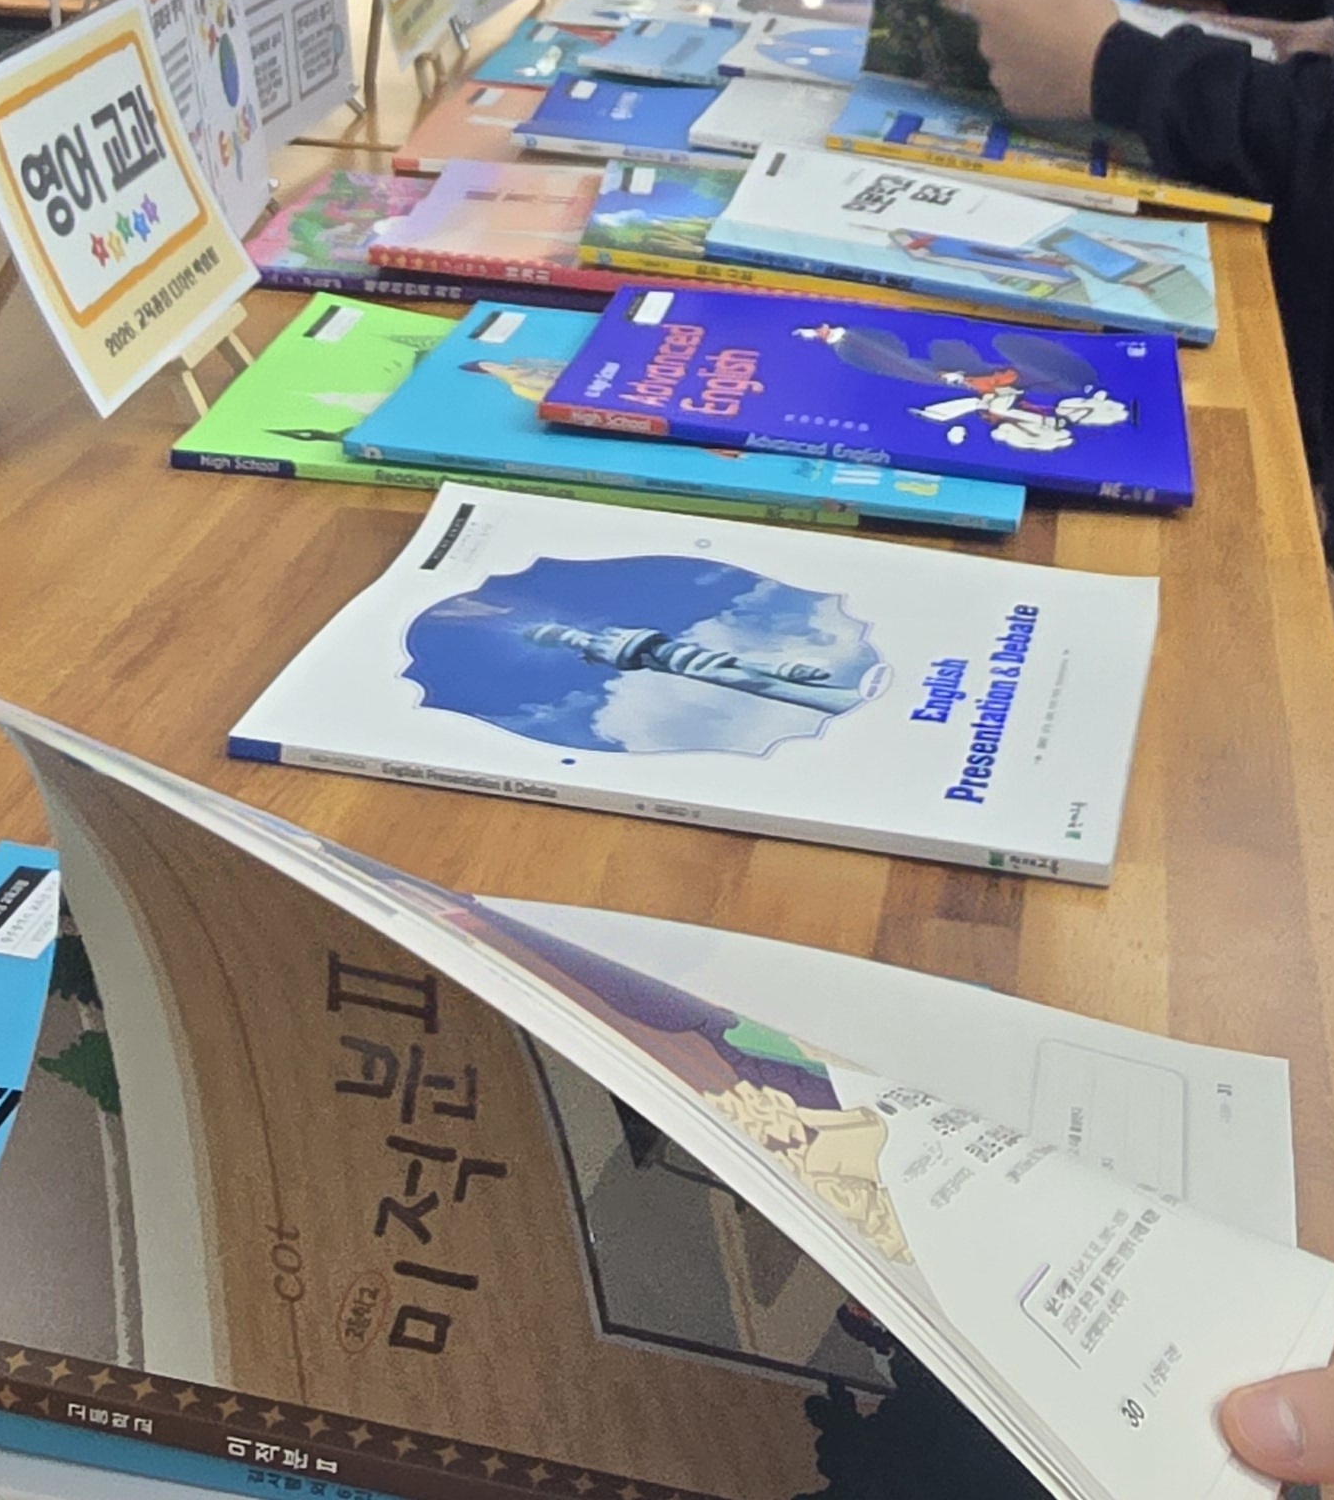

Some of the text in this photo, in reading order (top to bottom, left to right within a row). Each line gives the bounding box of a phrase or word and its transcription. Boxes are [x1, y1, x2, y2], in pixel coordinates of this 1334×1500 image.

[19, 83, 167, 238] 영어 교과
[618, 322, 706, 409] Advanced
[679, 348, 765, 416] English
[570, 409, 653, 435] High School
[745, 432, 892, 466] Advanced English
[199, 453, 281, 473] High School
[910, 657, 970, 724] English
[944, 603, 1040, 805] Presentation & Debate
[334, 1035, 508, 1356] 미적분
[265, 1218, 306, 1304] cot
[66, 1401, 154, 1436] 고등학교
[226, 1435, 310, 1470] 미적분
[1121, 1397, 1146, 1429] 30
